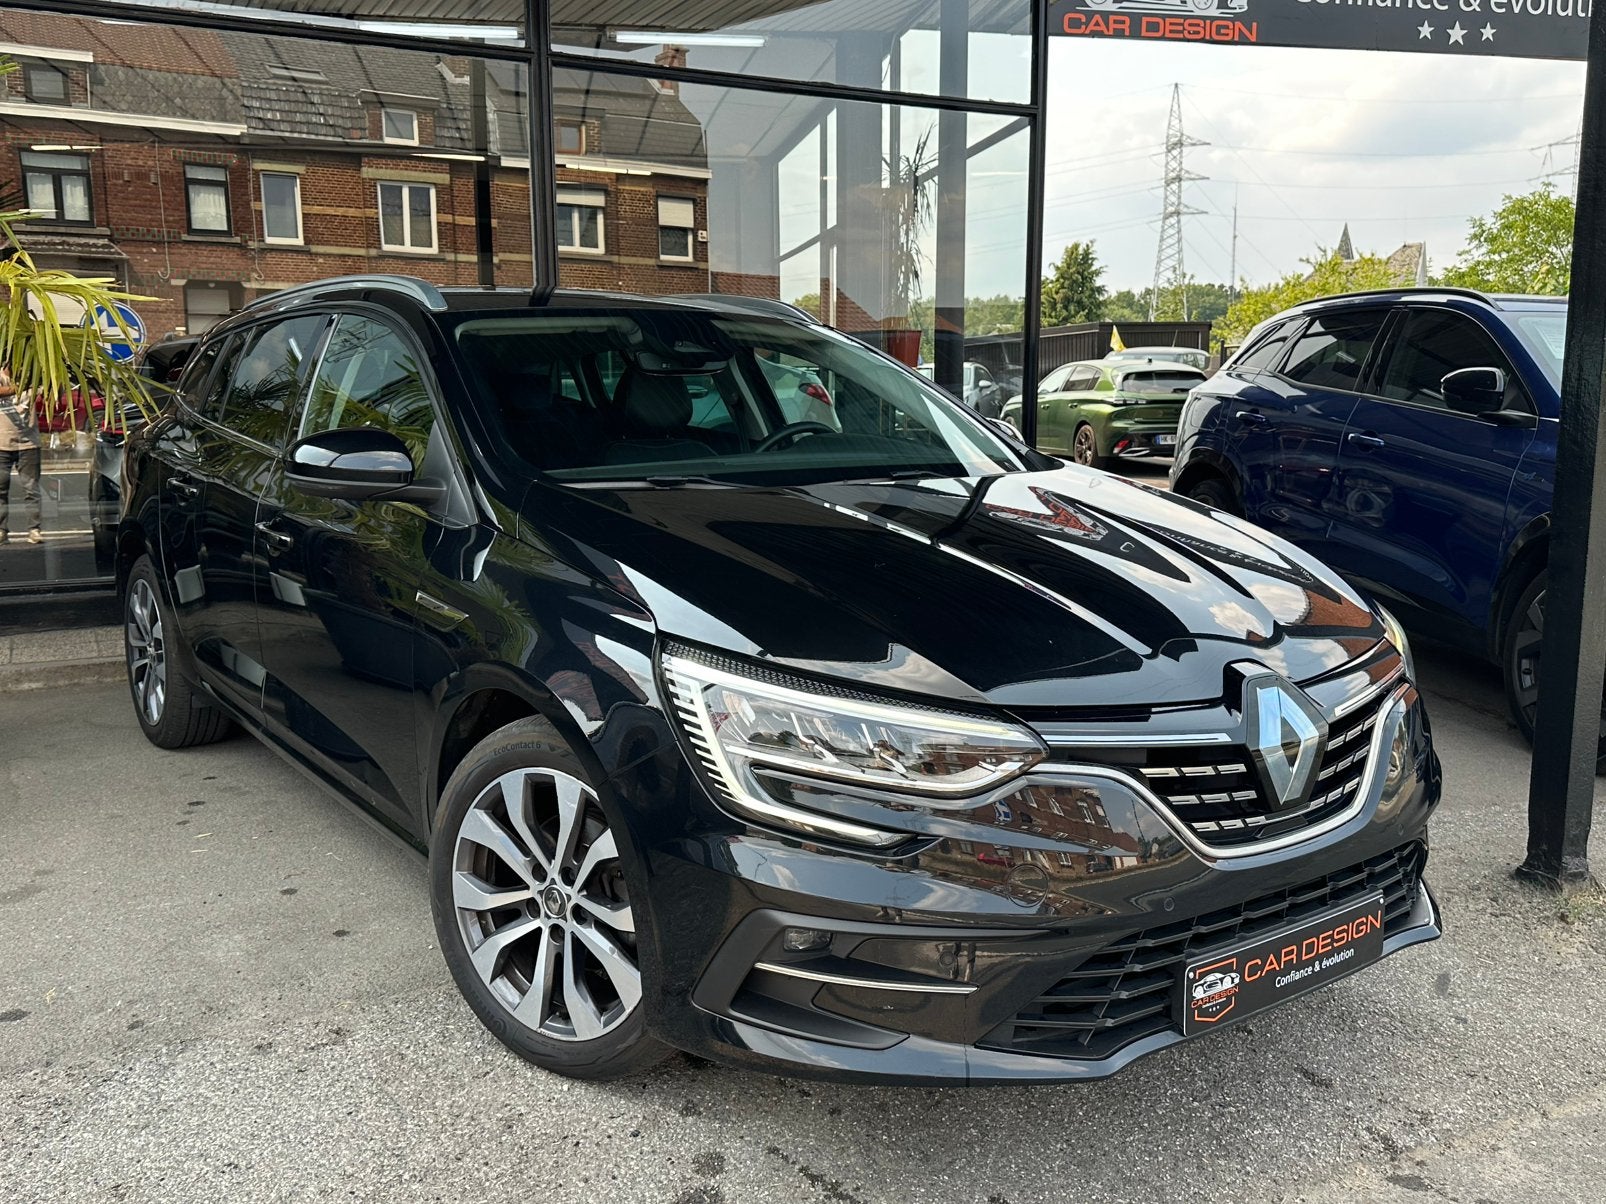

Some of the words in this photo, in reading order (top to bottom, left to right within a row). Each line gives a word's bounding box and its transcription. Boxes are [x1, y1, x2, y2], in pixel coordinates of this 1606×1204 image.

[1063, 13, 1130, 36] CAR
[1141, 16, 1258, 42] DESIGN
[494, 741, 535, 756] EcoContact
[1244, 945, 1297, 982] CAR
[1302, 910, 1381, 961] DESIGN
[1275, 967, 1313, 988] Confiance
[1314, 960, 1321, 971] &
[1321, 948, 1355, 969] évolution
[1191, 997, 1209, 1008] CAR
[1210, 986, 1239, 1002] DESIGN
